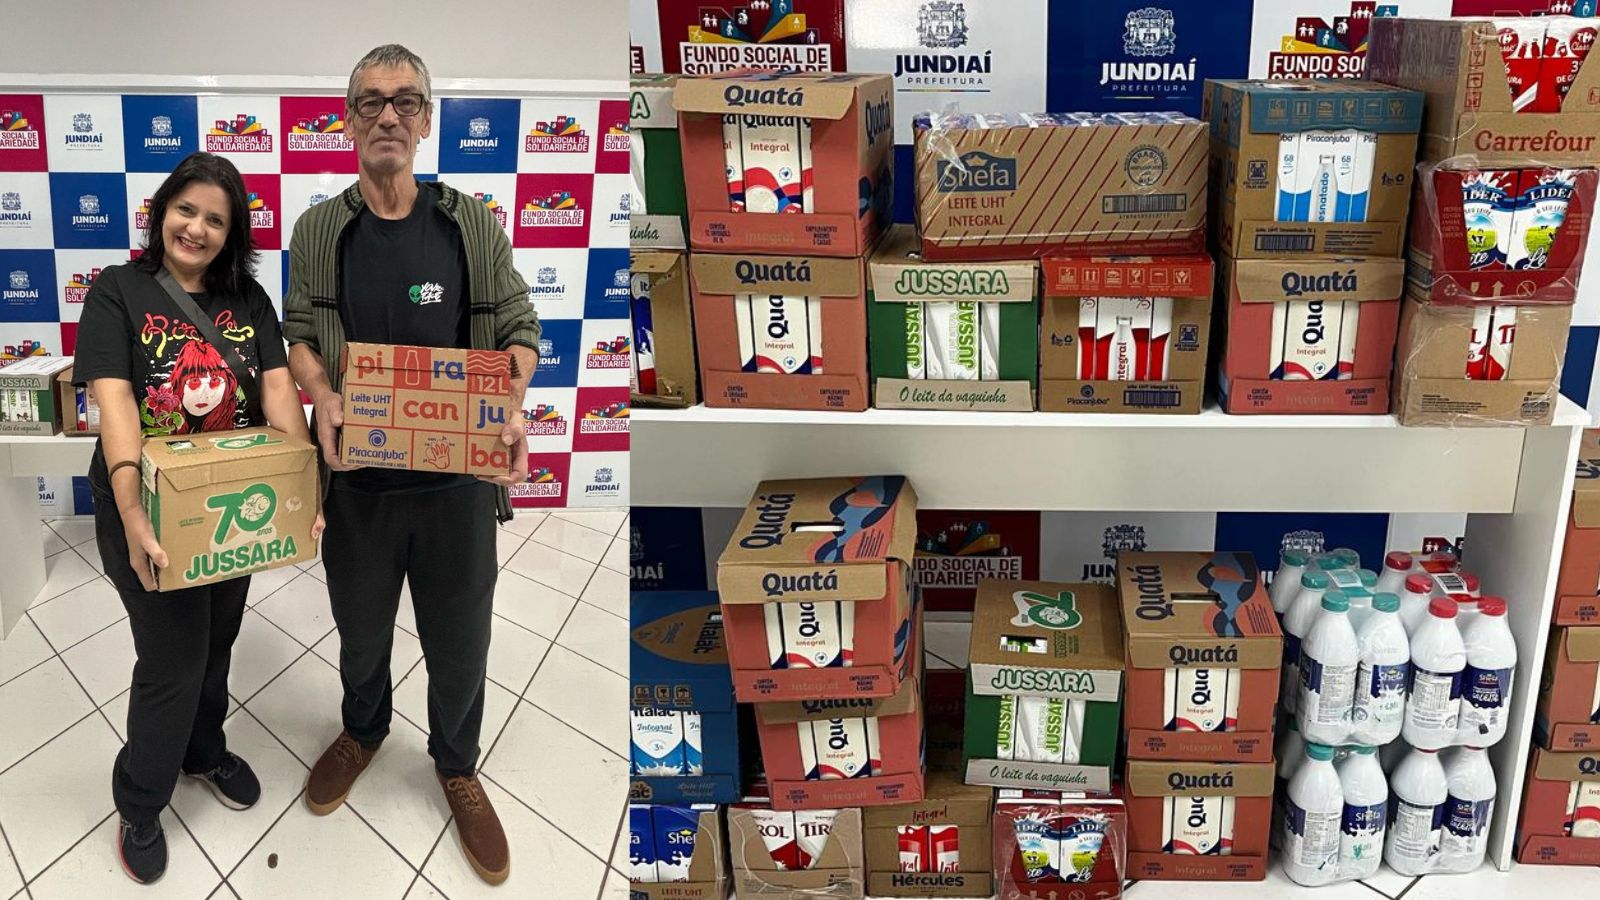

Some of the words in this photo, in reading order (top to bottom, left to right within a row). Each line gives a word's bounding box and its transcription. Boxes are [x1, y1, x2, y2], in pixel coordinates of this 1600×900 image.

[630, 50, 642, 65] E
[684, 46, 739, 63] FUNDO
[744, 46, 802, 63] SOCIAL
[806, 47, 828, 64] DE
[894, 50, 992, 78] JUNDIAÍ
[1100, 58, 1197, 85] JUNDIAÍ
[1272, 56, 1334, 73] FUNDO
[907, 77, 984, 85] PREFEITURA
[1556, 75, 1566, 83] DE
[724, 82, 804, 107] Quatá
[1112, 84, 1187, 92] PREFEITURA
[865, 91, 891, 145] Quatá
[27, 132, 38, 140] DE
[64, 132, 103, 144] JUNDIAÍ
[144, 136, 181, 147] JUNDIAÍ
[207, 135, 233, 143] FUNDO
[234, 135, 259, 144] SOCIAL
[260, 136, 271, 144] DE
[289, 134, 314, 142] FUNDO
[315, 134, 340, 142] SOCIAL
[459, 137, 498, 148] JUNDIAÍ
[526, 136, 551, 144] FUNDO
[552, 136, 577, 144] SOCIAL
[578, 136, 588, 144] DE
[1306, 134, 1351, 145] Piracanjuba
[1474, 130, 1596, 153] Carrefour
[0, 140, 38, 148] ARIEDADE
[207, 143, 272, 152] SOLIDARIEDADE
[289, 141, 350, 150] SOLIDARIEDADE
[526, 143, 588, 152] SOLIDARIEDADE
[750, 142, 790, 154] Integral
[1284, 154, 1294, 163] 68
[1341, 154, 1352, 163] 68
[943, 167, 1010, 188] Shefa
[948, 196, 978, 209] LEITE
[982, 196, 1006, 209] UHT
[1318, 171, 1330, 221] esnatado
[1463, 188, 1501, 202] IDER
[0, 210, 31, 222] UNDIAÍ
[72, 214, 109, 225] JUNDIAÍ
[522, 210, 547, 218] FUNDO
[547, 210, 572, 218] SOCIAL
[573, 210, 582, 218] DE
[522, 217, 583, 225] SOLIDARIEDADE
[948, 214, 1006, 227] INTEGRAL
[630, 223, 660, 241] uinha
[735, 260, 811, 285] Quatá
[895, 268, 1010, 295] JUSSARA
[1281, 269, 1357, 296] Quatá
[3, 289, 39, 299] JUNDIAÍ
[528, 284, 565, 295] JUNDIAÍ
[604, 288, 630, 297] JUNDI
[767, 295, 790, 340] Qua
[1302, 301, 1325, 345] Qua
[906, 302, 924, 369] JUSSAR
[956, 302, 977, 370] JUSSAR
[764, 341, 795, 350] Integral
[1296, 348, 1326, 356] Integral
[357, 350, 385, 380] pi
[1117, 342, 1128, 380] ntegral
[433, 360, 466, 381] ra
[0, 377, 41, 388] USSARA
[350, 392, 371, 404] Leite
[373, 394, 392, 405] UHT
[899, 388, 910, 402] O
[911, 387, 935, 403] leite
[936, 388, 952, 403] da
[954, 391, 1008, 410] vaquinha
[402, 399, 460, 422] can
[476, 399, 506, 429] ju
[348, 446, 406, 461] Piracanjuba
[470, 443, 509, 470] ba
[551, 483, 560, 491] DE
[585, 483, 620, 492] JUNDIAÍ
[207, 483, 277, 545] 70
[739, 493, 796, 550] Quatá
[184, 535, 298, 582] JUSSARA
[942, 558, 996, 571] SOCIAL
[1000, 558, 1019, 571] DE
[762, 569, 839, 597] Quatá
[1127, 565, 1175, 621] Quatá
[799, 601, 821, 638] Qua
[1169, 644, 1238, 665] Quatá
[992, 669, 1095, 693] JUSSARA
[1191, 669, 1211, 705] Qua
[996, 694, 1014, 750] JUSSAR
[1046, 698, 1062, 754] JUSSAR
[828, 718, 849, 750] Qua
[990, 765, 999, 778] O
[1000, 766, 1023, 780] leite
[1025, 767, 1039, 781] da
[1040, 769, 1088, 786] vaquinha
[1168, 771, 1234, 791] Quatá
[911, 805, 948, 822] Integral
[1187, 796, 1207, 828] Qua
[758, 825, 790, 838] ROL
[800, 822, 833, 838] TIR
[1016, 823, 1048, 834] IDER
[1072, 823, 1102, 833] LIDE
[892, 874, 964, 888] Hércules
